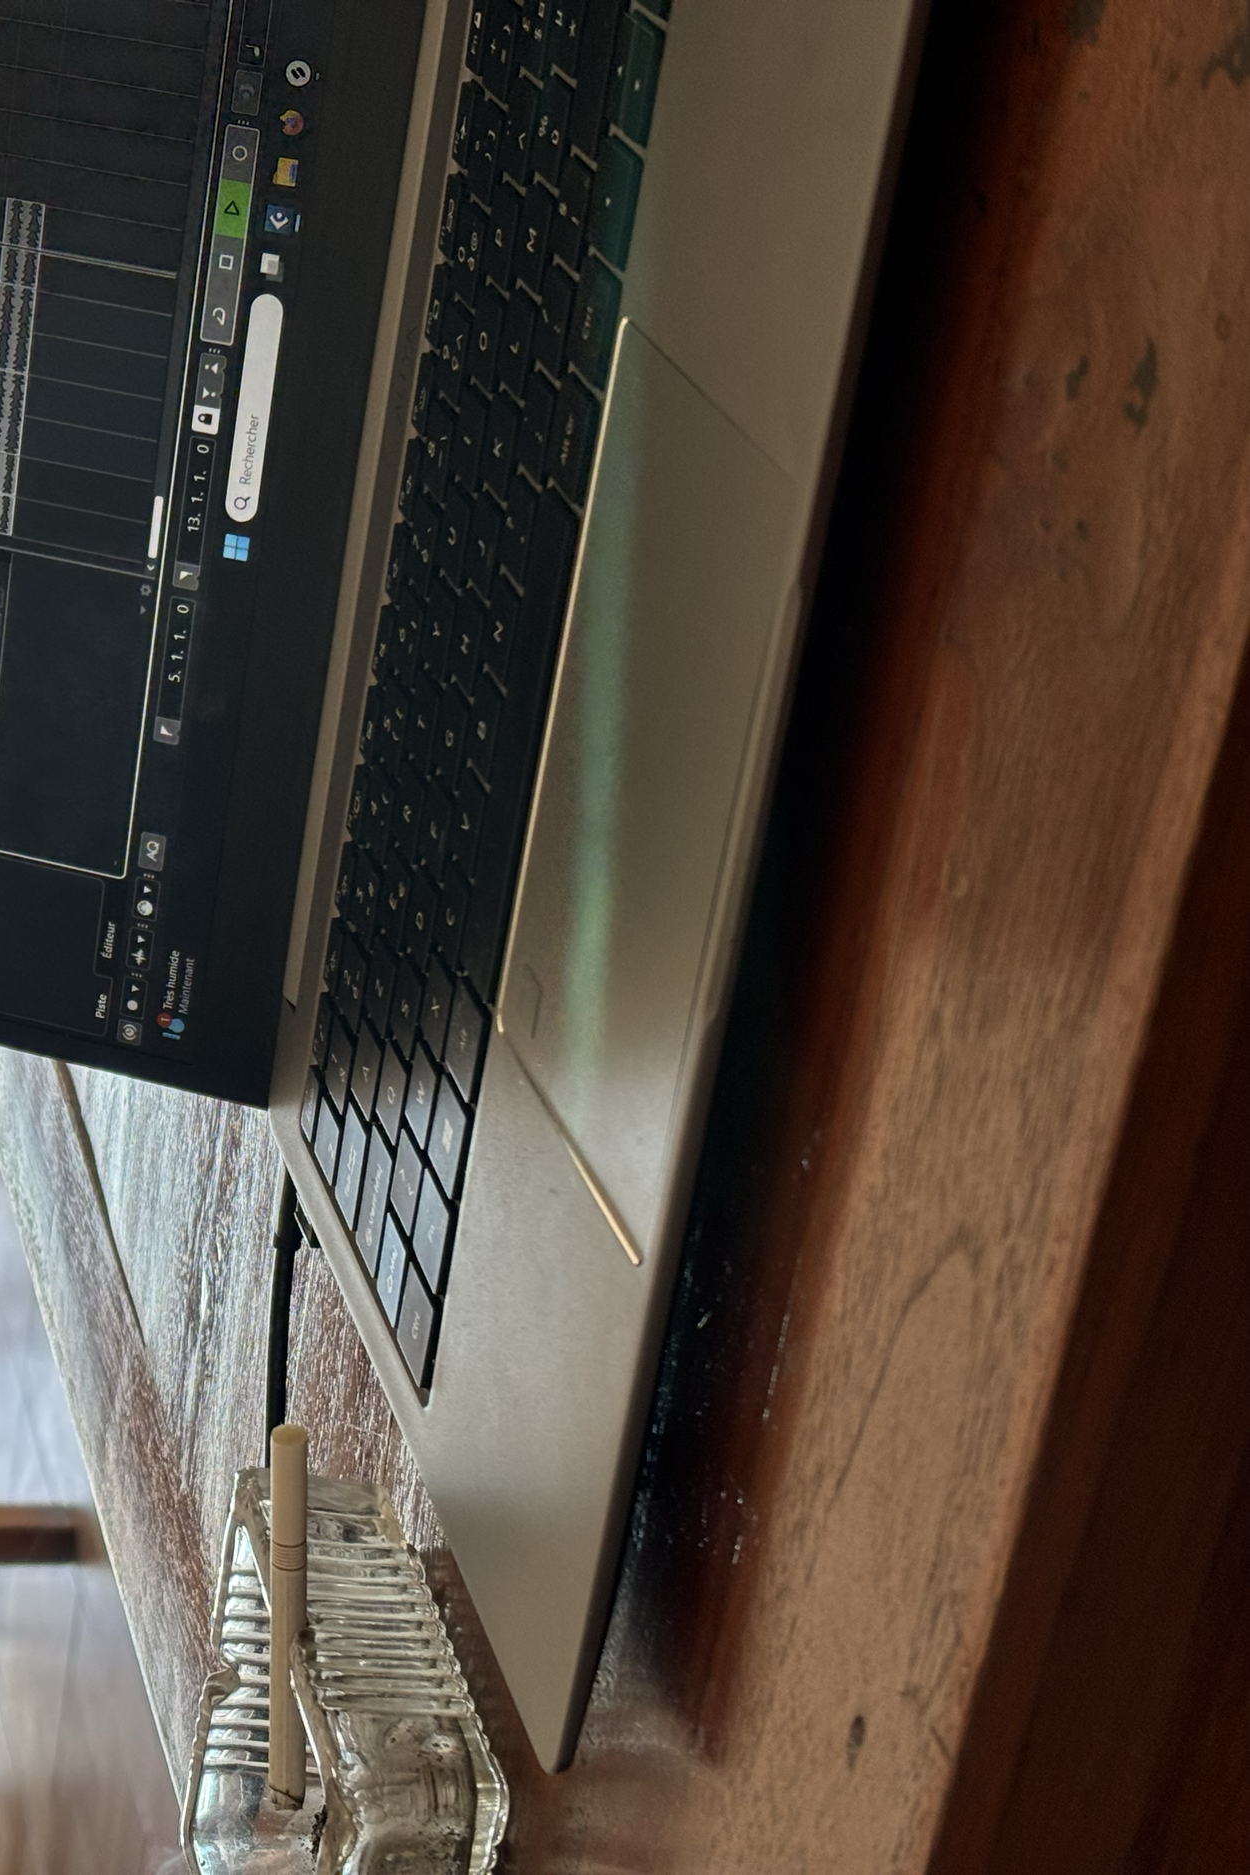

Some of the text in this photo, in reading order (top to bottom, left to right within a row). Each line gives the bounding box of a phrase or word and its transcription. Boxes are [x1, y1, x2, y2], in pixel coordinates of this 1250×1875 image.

[469, 34, 479, 55] Fn
[494, 228, 504, 248] P
[526, 227, 538, 253] M
[581, 305, 594, 341] Ctrl
[478, 330, 488, 352] O
[197, 444, 210, 454] 0
[238, 414, 262, 486] Rechercher
[492, 437, 503, 458] K
[559, 438, 571, 466] Alt
[447, 526, 457, 546] U
[476, 538, 487, 557] J
[177, 604, 190, 614] 0
[492, 620, 504, 643] N
[460, 633, 470, 655] H
[416, 714, 425, 729] T
[402, 804, 412, 823] R
[460, 812, 470, 830] V
[146, 840, 159, 861] AQ
[446, 907, 456, 926] C
[100, 922, 116, 959] Éditeur
[162, 950, 180, 1009] Très humide
[178, 958, 195, 1014] Maintenant
[374, 978, 384, 998] Z
[95, 993, 108, 1019] Piste
[400, 999, 409, 1018] S
[430, 998, 441, 1018] X
[459, 1028, 468, 1052] Alt
[360, 1066, 370, 1082] A
[386, 1085, 396, 1104] Q
[415, 1081, 426, 1105] W
[368, 1162, 384, 1226] Verr Maj
[426, 1225, 436, 1244] Fn
[388, 1244, 399, 1273] Maj
[410, 1311, 421, 1340] Ctrl
